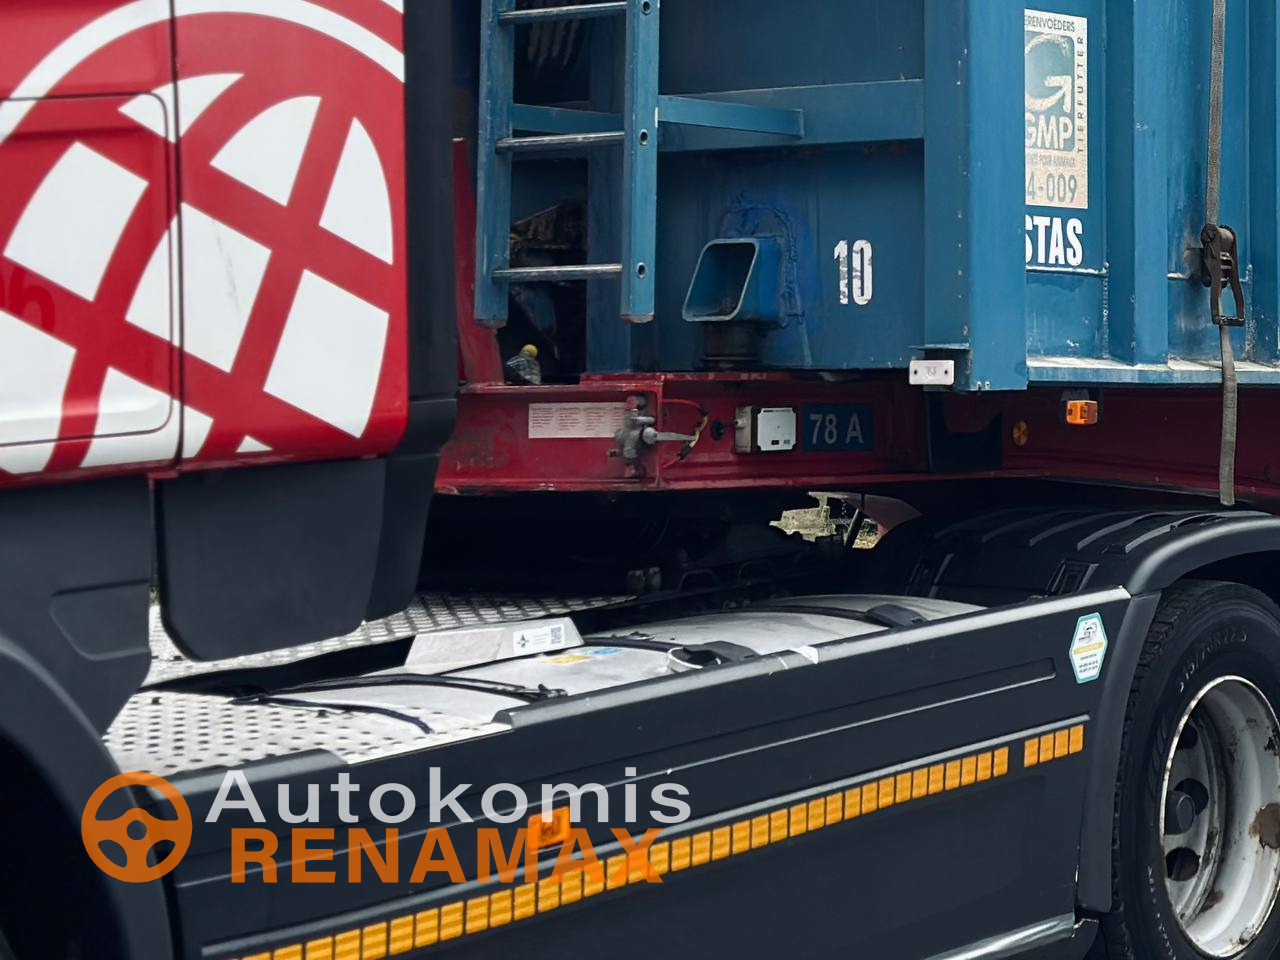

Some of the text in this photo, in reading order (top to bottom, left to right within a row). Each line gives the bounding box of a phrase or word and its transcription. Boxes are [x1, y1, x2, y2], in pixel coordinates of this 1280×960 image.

[1076, 37, 1084, 153] TIERFUTTER
[834, 239, 873, 305] 10
[809, 412, 864, 445] 78 A
